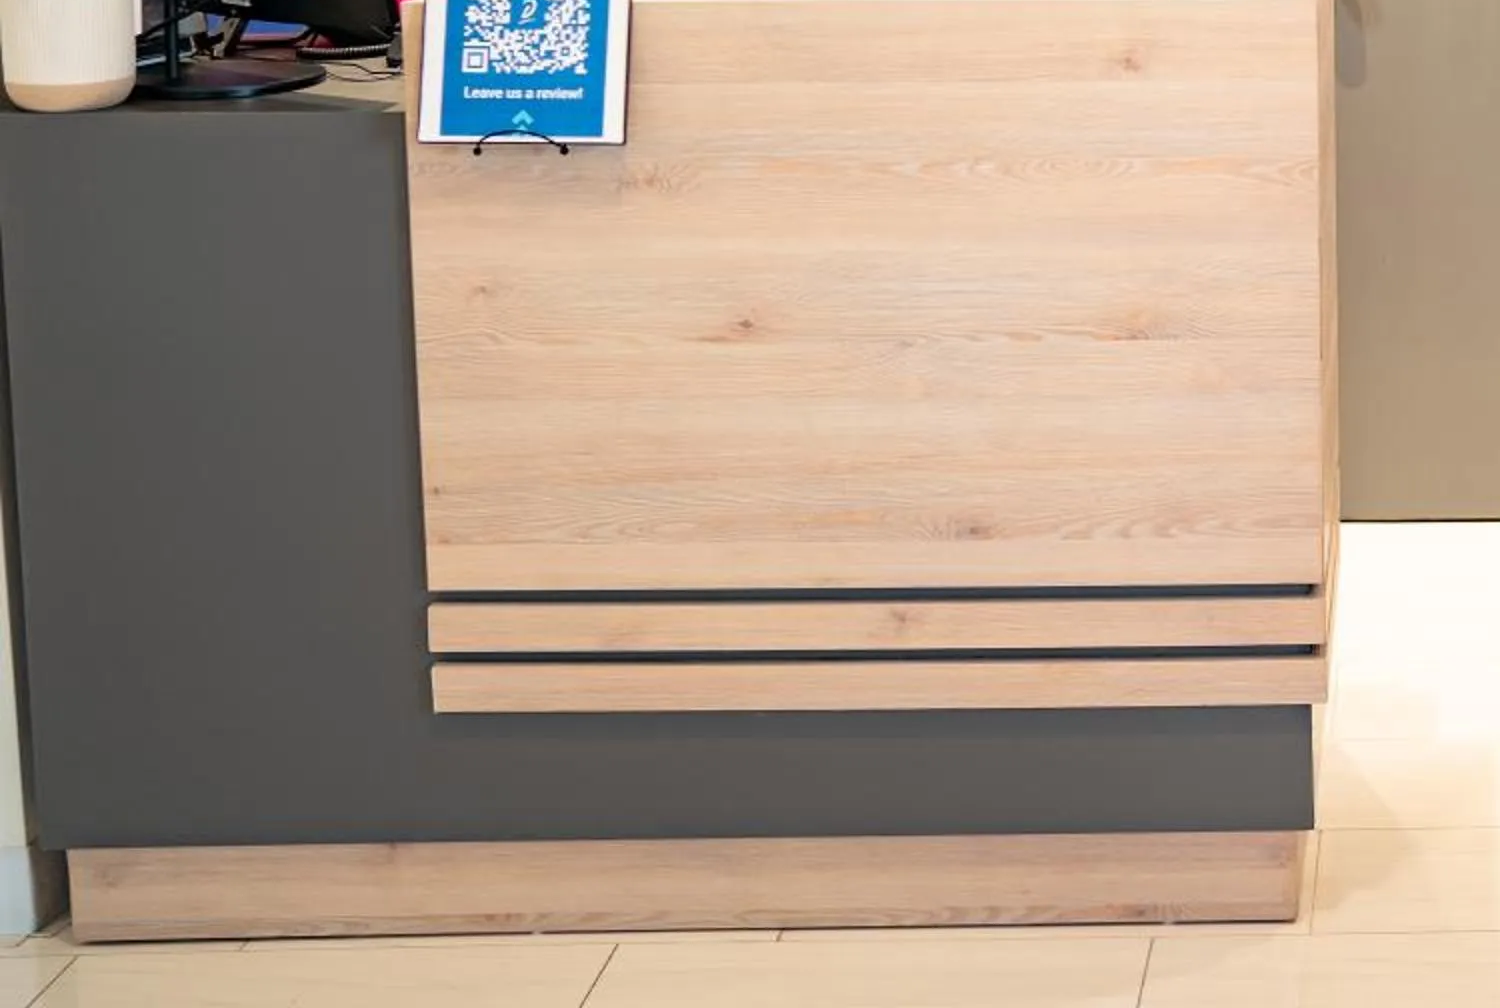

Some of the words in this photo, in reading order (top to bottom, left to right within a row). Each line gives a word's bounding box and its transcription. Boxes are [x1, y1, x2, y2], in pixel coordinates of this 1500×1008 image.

[463, 85, 504, 99] Leave
[505, 88, 522, 99] us
[524, 88, 535, 99] a
[536, 87, 584, 100] review!
